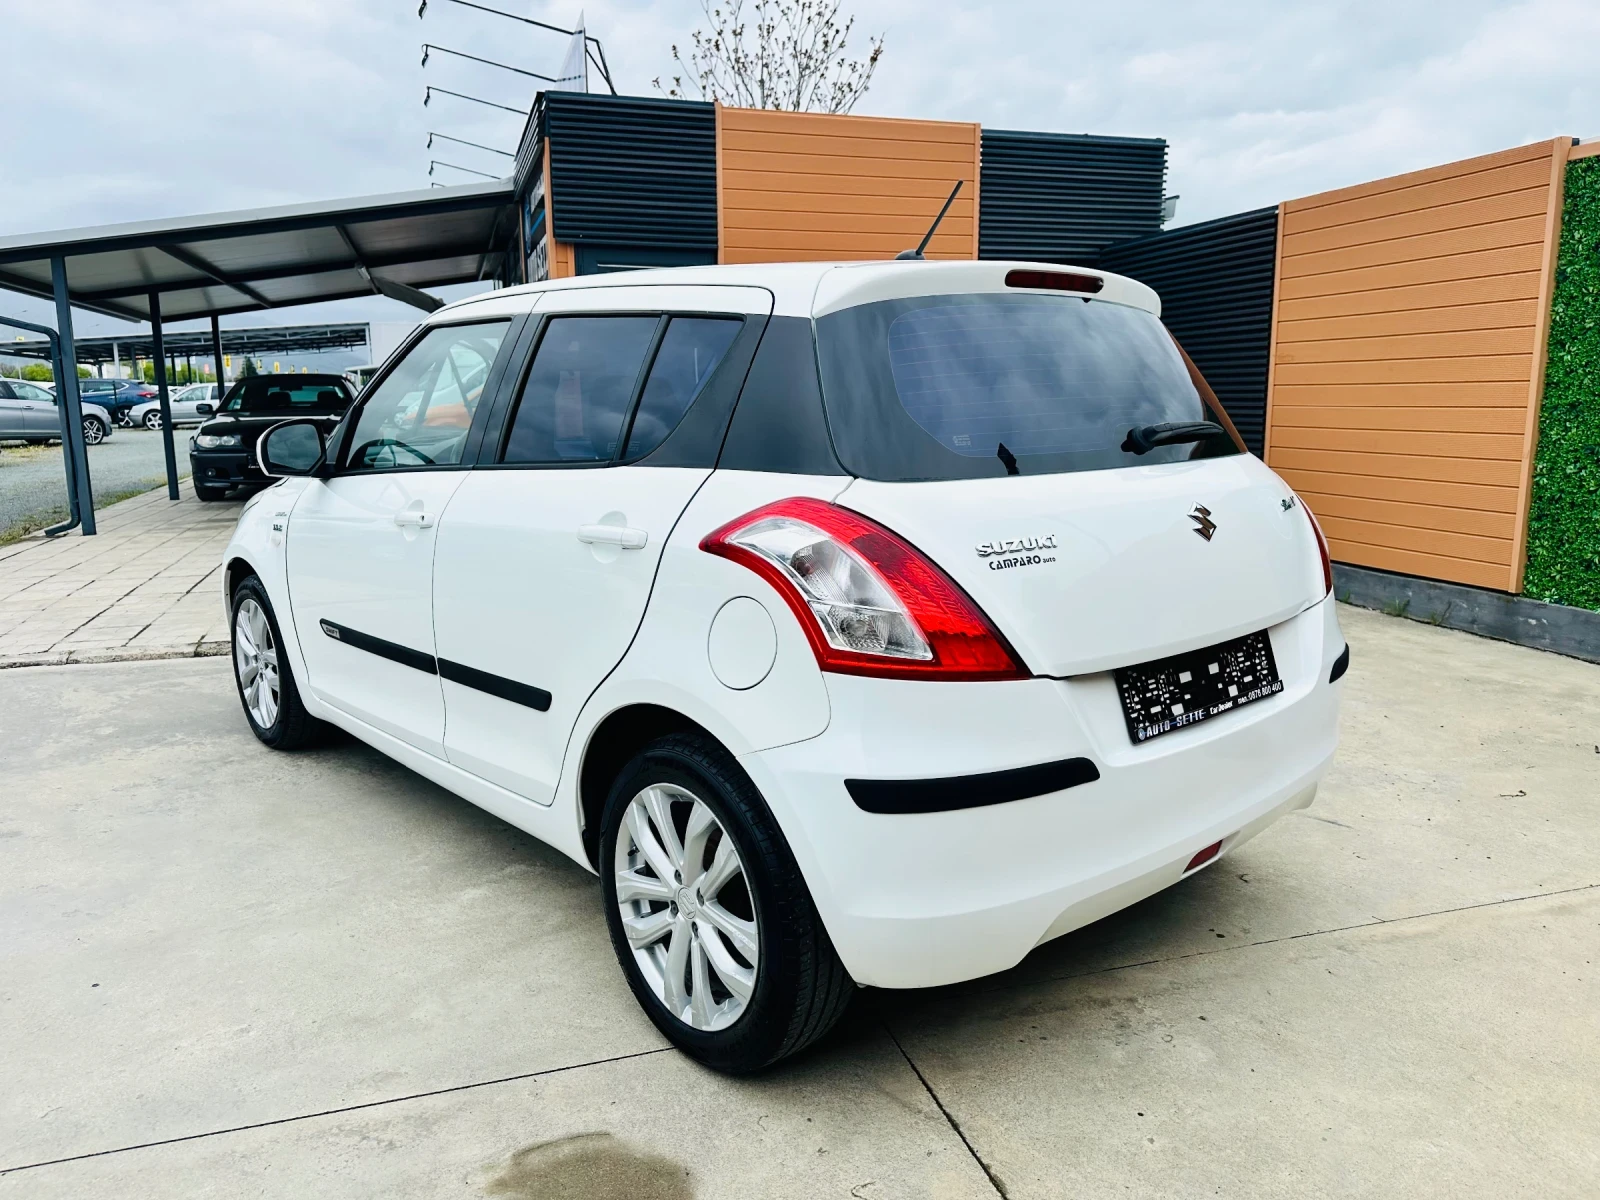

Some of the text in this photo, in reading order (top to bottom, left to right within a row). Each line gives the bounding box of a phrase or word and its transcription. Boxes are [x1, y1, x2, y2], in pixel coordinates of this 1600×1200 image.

[975, 534, 1058, 558] SUZUKI
[989, 555, 1041, 570] CAMPARO
[1146, 720, 1170, 737] AUTO
[1176, 708, 1205, 727] SETTE
